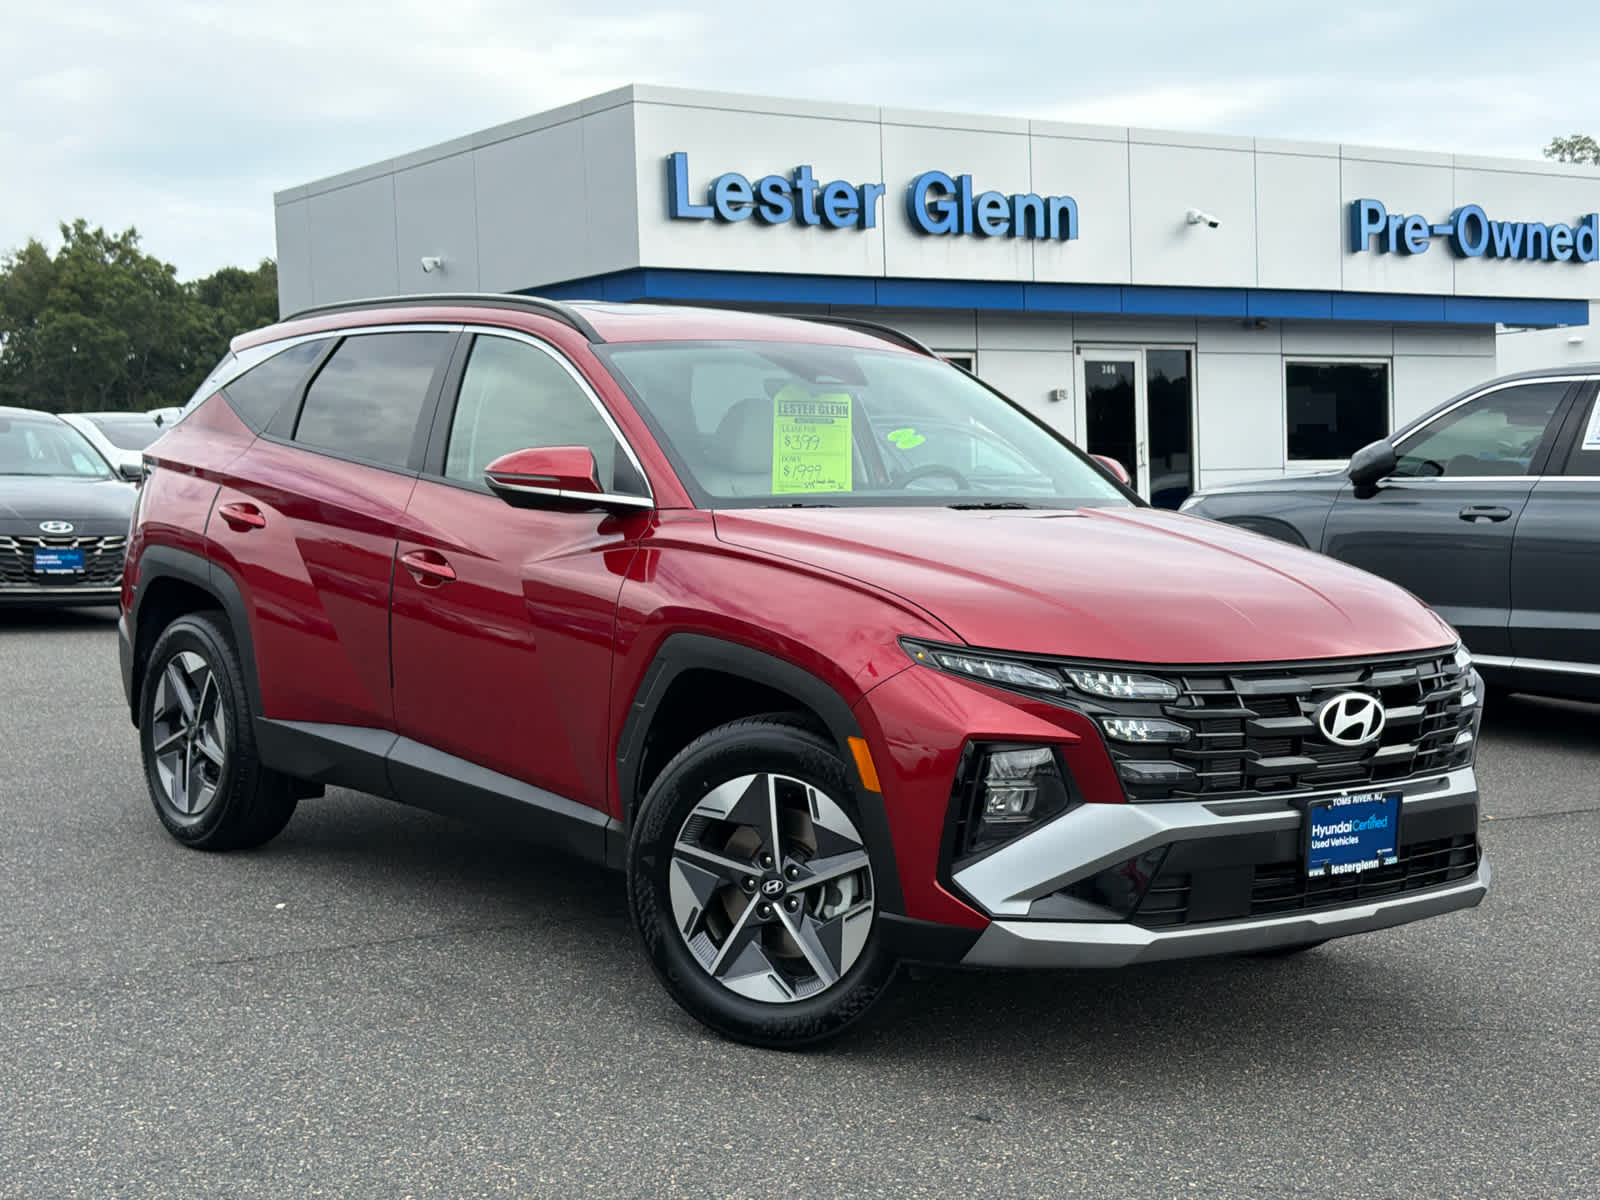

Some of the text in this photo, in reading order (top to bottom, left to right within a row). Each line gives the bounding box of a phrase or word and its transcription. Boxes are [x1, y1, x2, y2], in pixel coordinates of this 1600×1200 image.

[667, 151, 1079, 241] Lester Glenn
[1351, 198, 1599, 263] Pre-Owned
[778, 403, 849, 416] LESTER GLENN
[1333, 796, 1352, 807] TOMS
[1311, 836, 1360, 849] Used Vehicles
